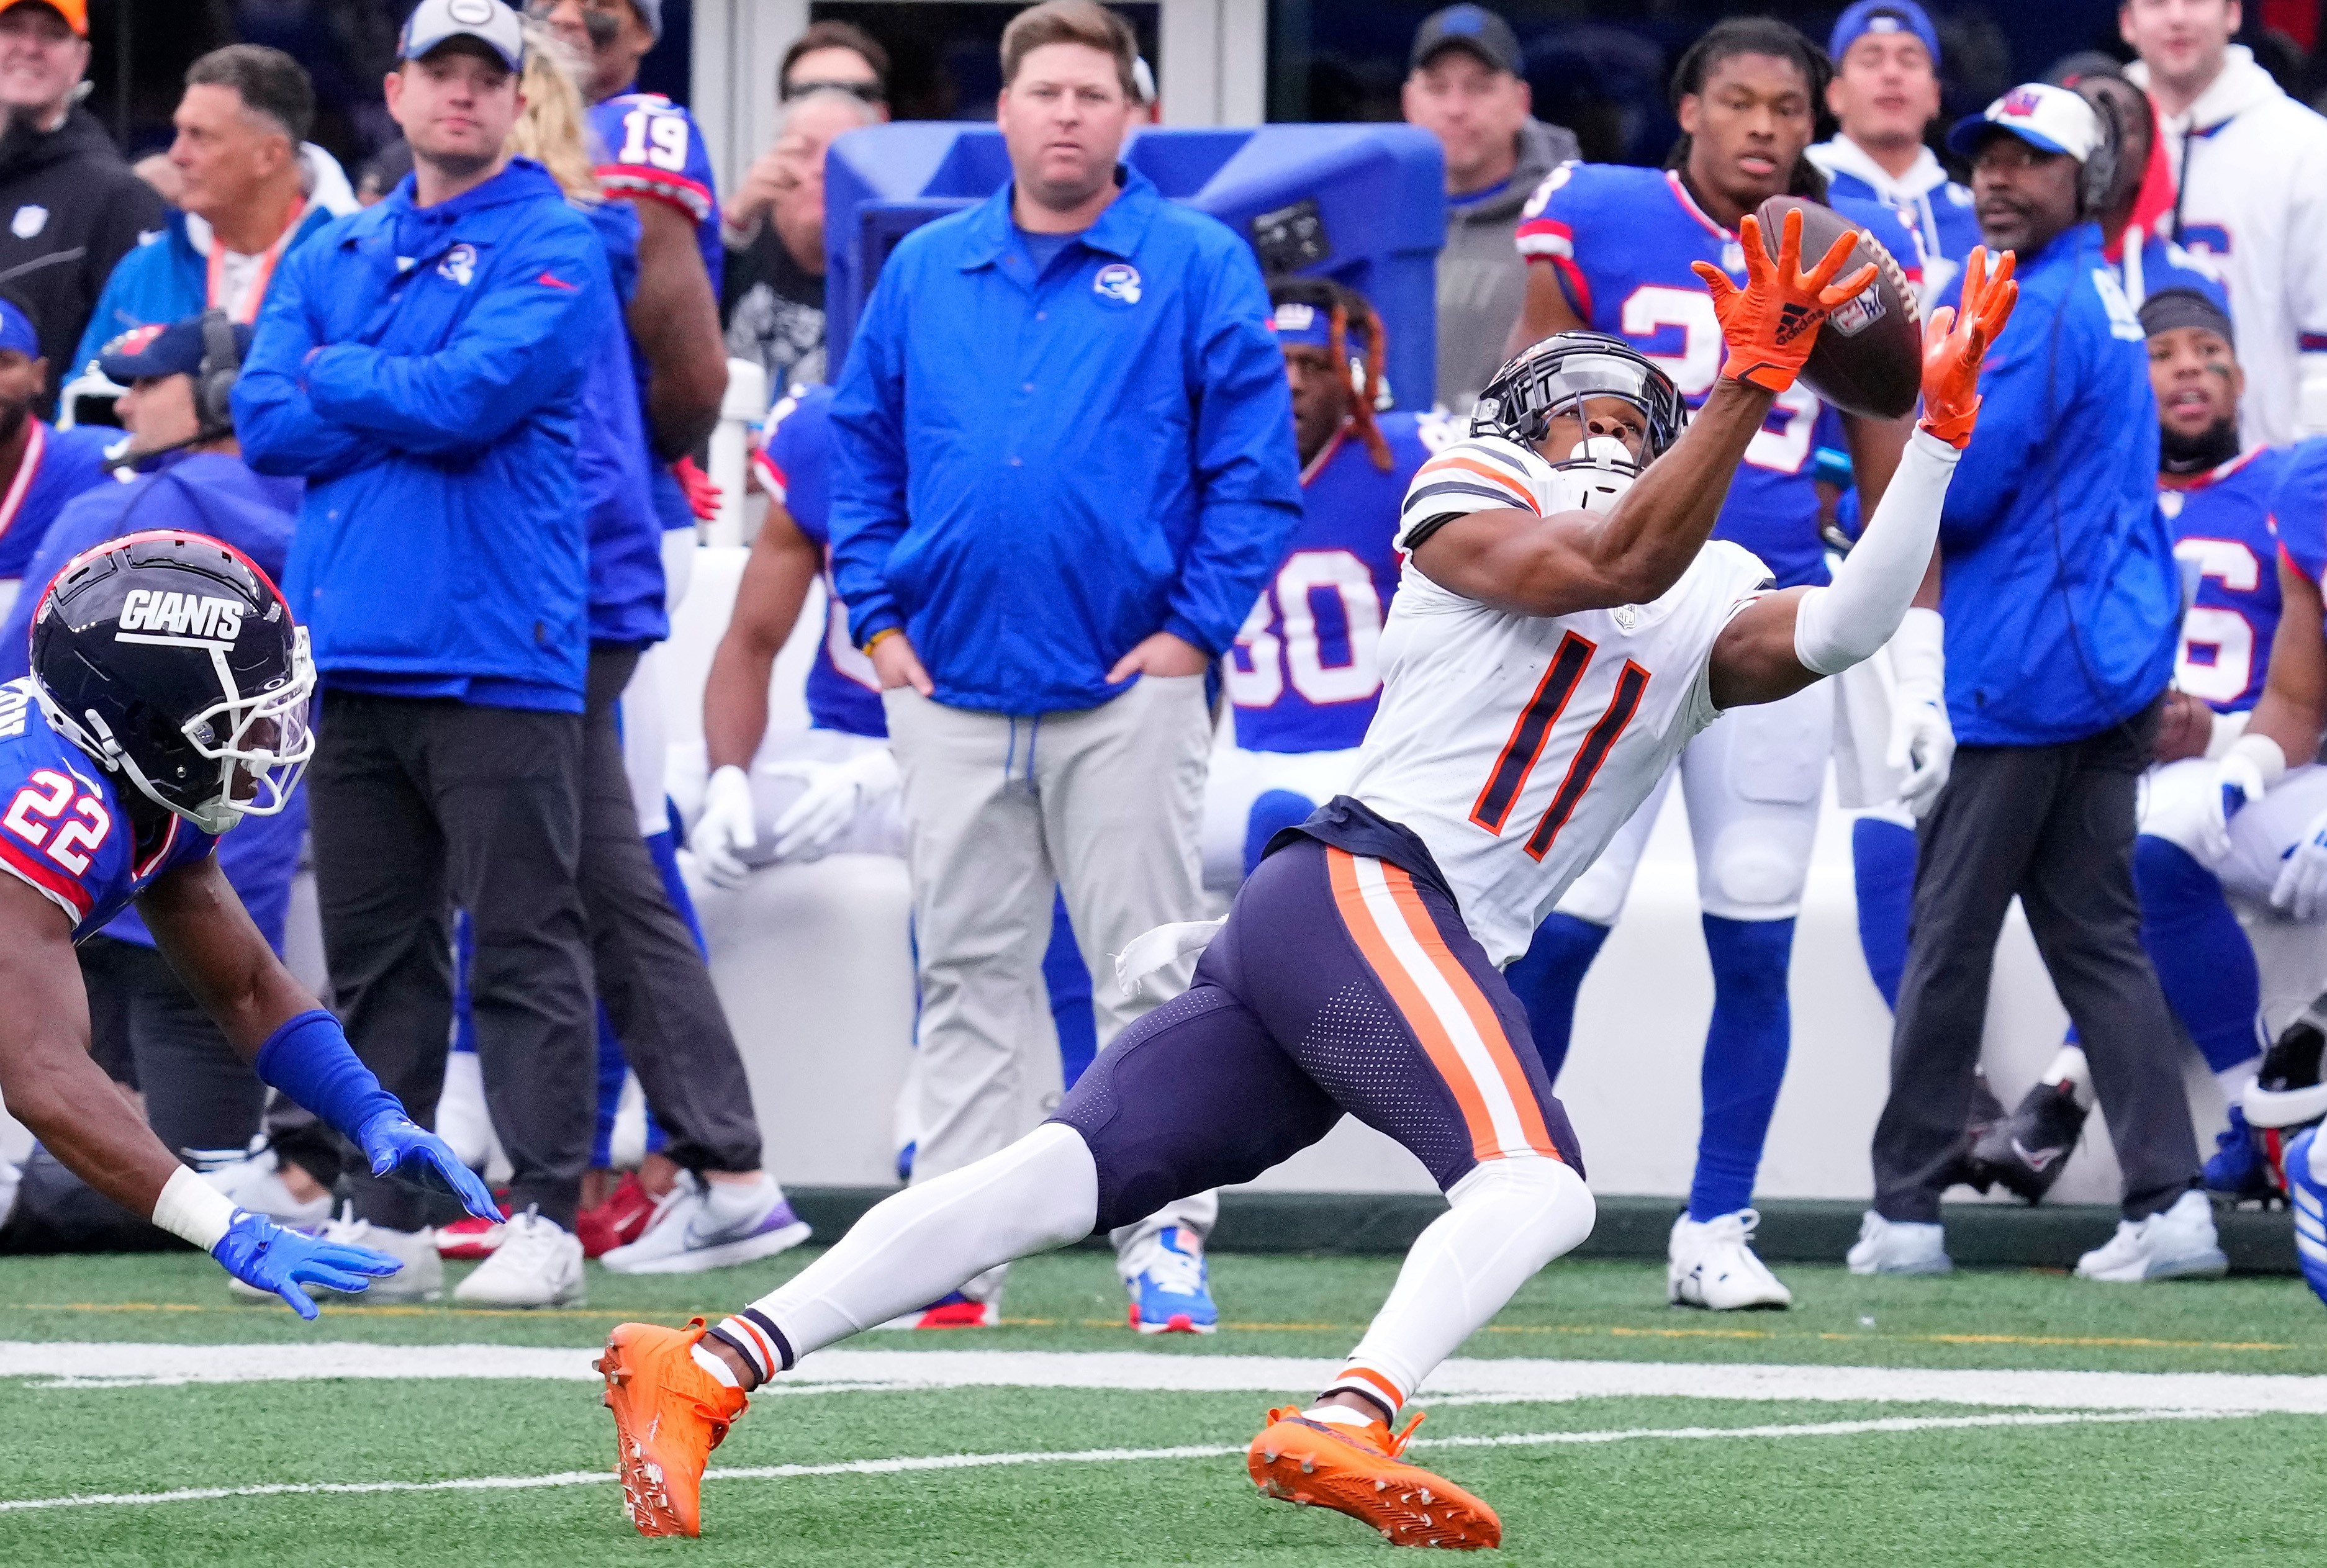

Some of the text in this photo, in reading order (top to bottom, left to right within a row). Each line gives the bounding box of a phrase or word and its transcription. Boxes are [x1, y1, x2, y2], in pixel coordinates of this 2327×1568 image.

[620, 110, 689, 172] 19
[1776, 309, 1825, 346] adidas
[118, 589, 245, 640] GIANTS
[1468, 629, 1651, 863] 11
[2, 768, 112, 878] 22
